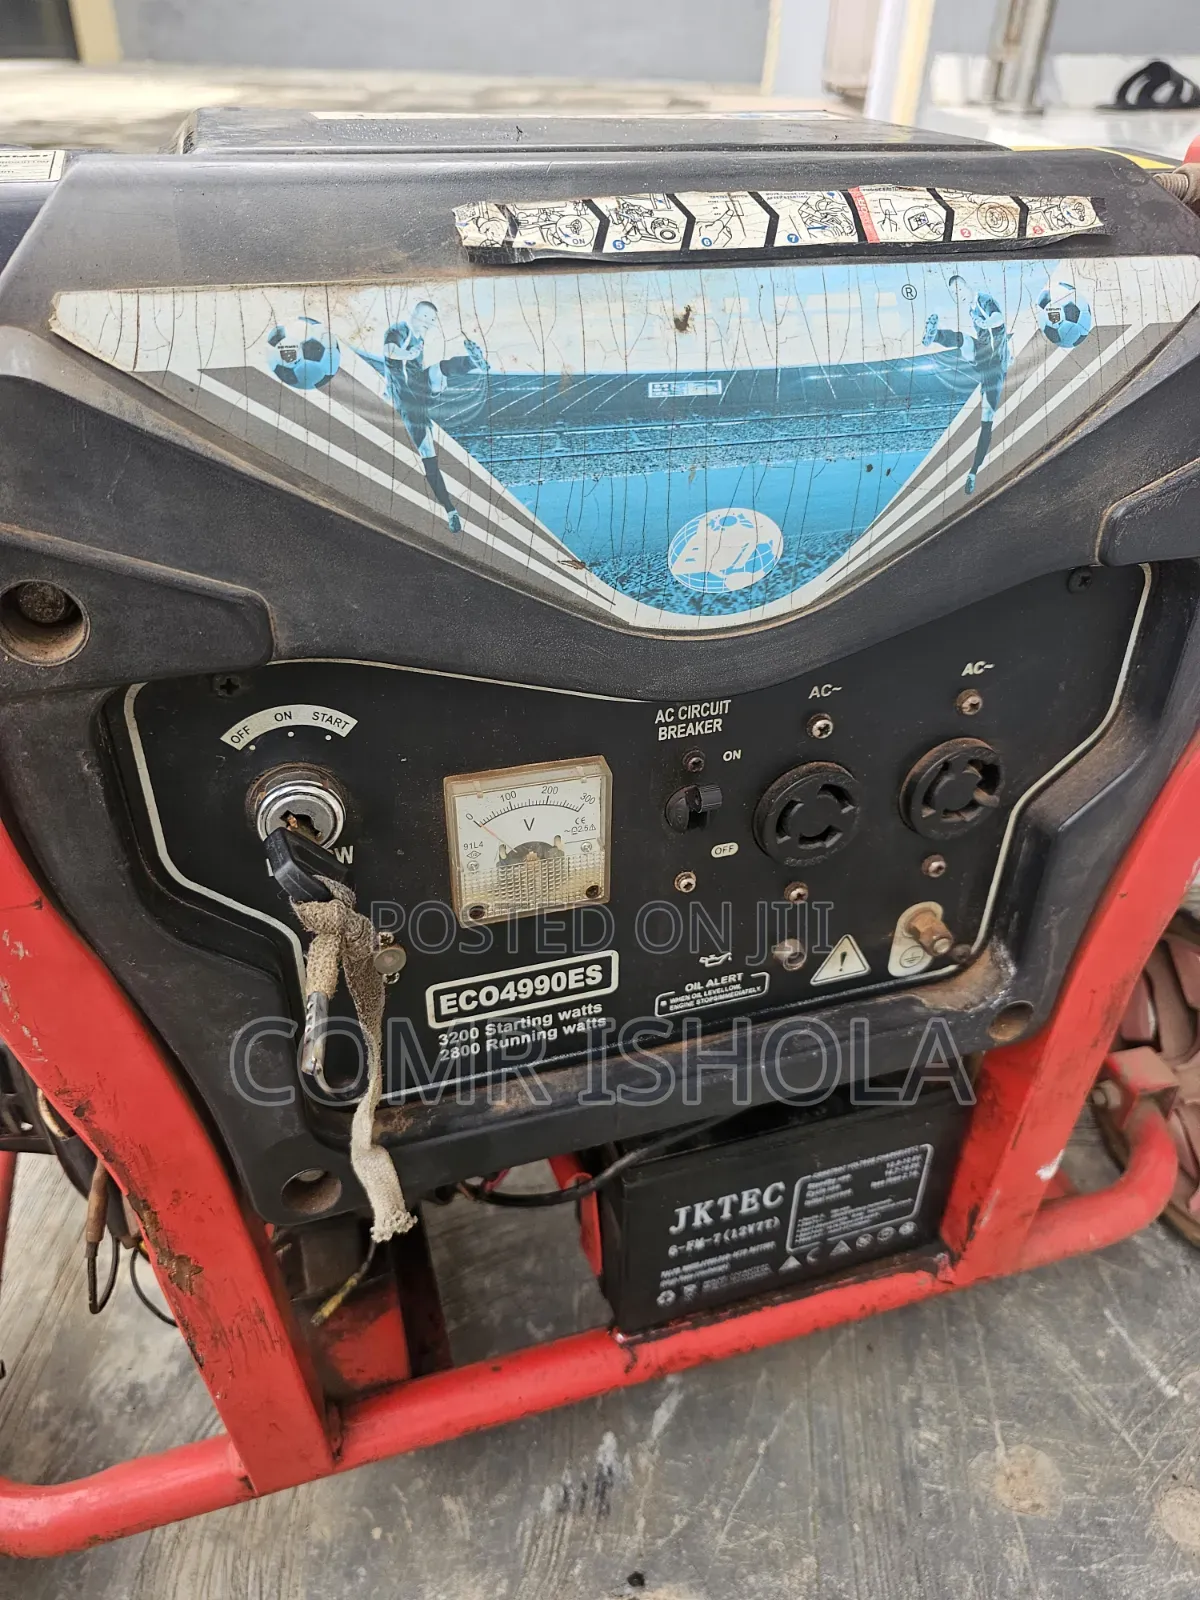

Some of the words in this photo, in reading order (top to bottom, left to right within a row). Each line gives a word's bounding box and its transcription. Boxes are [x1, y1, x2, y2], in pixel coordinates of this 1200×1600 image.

[274, 711, 293, 722] ON
[655, 708, 675, 723] AC
[678, 700, 731, 720] CIRCUIT
[312, 711, 350, 730] START
[230, 725, 251, 744] OFF
[658, 718, 723, 741] BREAKER
[722, 750, 742, 761] ON
[499, 790, 517, 802] 100
[541, 785, 559, 795] 200
[579, 793, 596, 805] 300
[465, 813, 474, 821] 0
[523, 817, 535, 831] V
[463, 841, 484, 850] 91L4
[714, 845, 735, 855] OFF
[684, 982, 704, 992] OIL
[706, 972, 744, 987] ALERT
[438, 964, 604, 1016] ECO4990ES
[669, 1001, 695, 1011] ENGINE
[438, 1027, 480, 1047] 3200
[484, 1013, 553, 1036] Starting
[557, 1002, 603, 1020] watts
[438, 1042, 481, 1062] 2800
[485, 1028, 559, 1052] Running
[562, 1016, 607, 1035] watts
[668, 1181, 786, 1235] JKTEC
